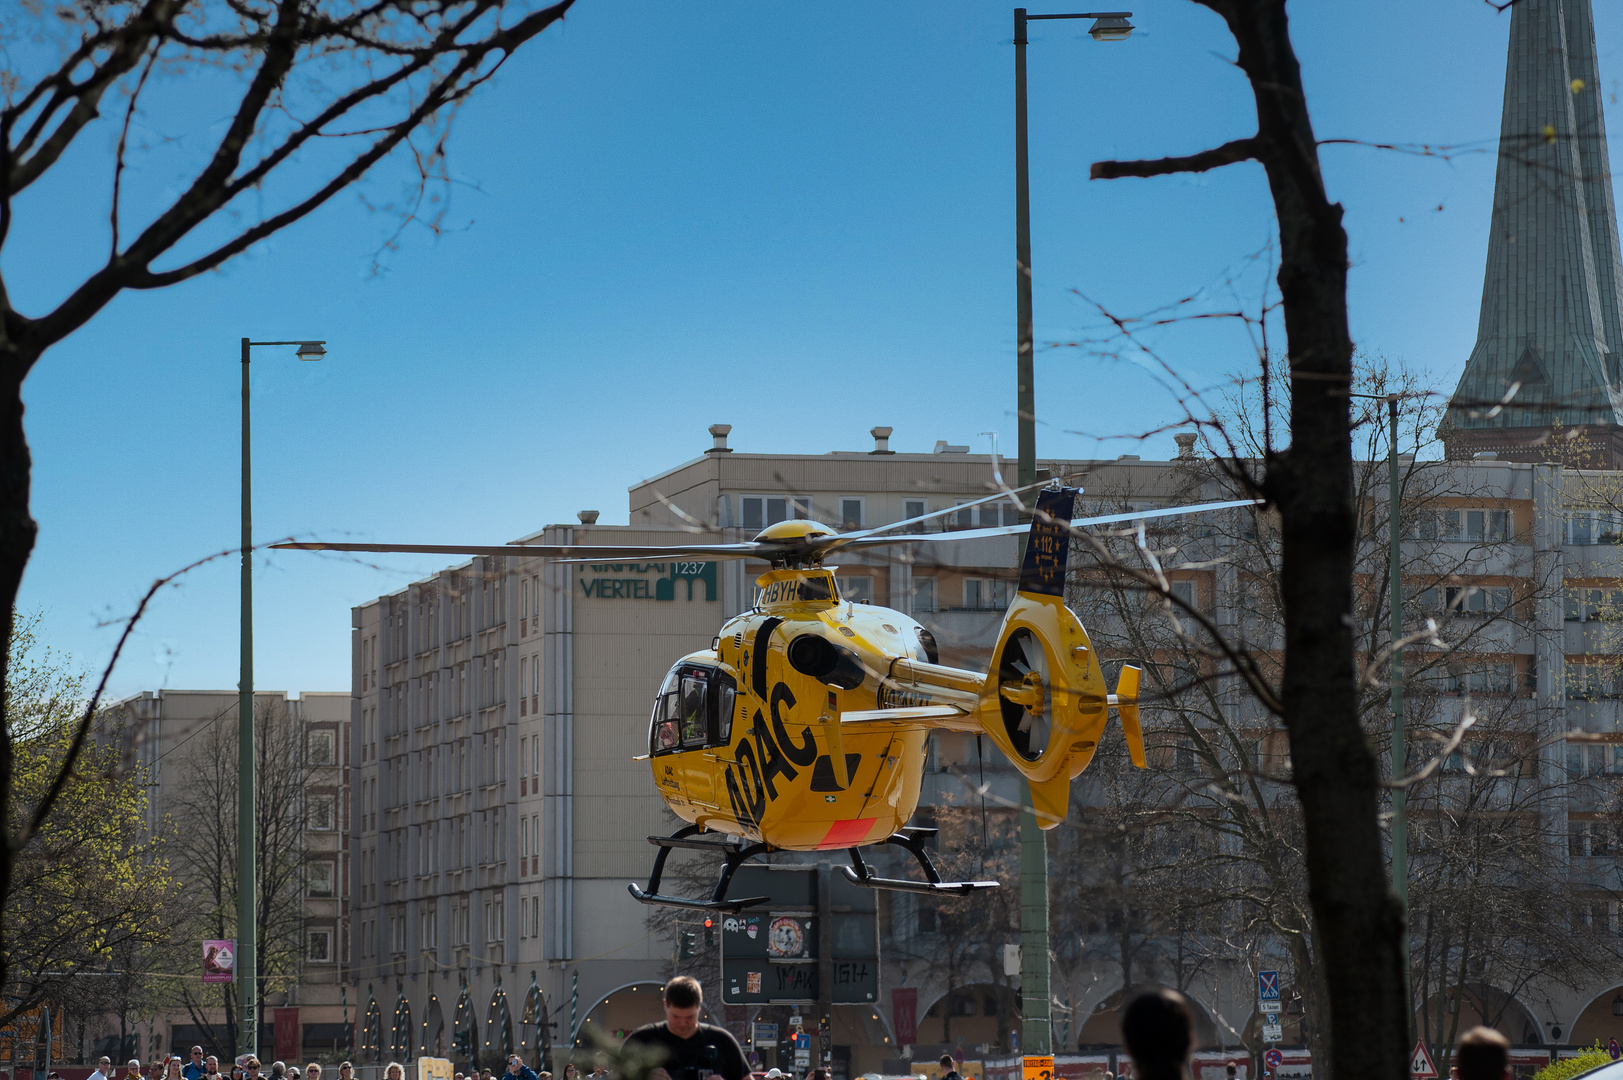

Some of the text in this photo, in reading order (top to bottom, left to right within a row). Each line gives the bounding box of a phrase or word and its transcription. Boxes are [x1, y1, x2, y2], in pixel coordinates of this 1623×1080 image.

[1041, 536, 1053, 553] 112
[675, 561, 707, 574] 1237
[580, 578, 655, 598] VIERTEL
[725, 681, 818, 841] ADAC
[1262, 990, 1279, 998] TAXI
